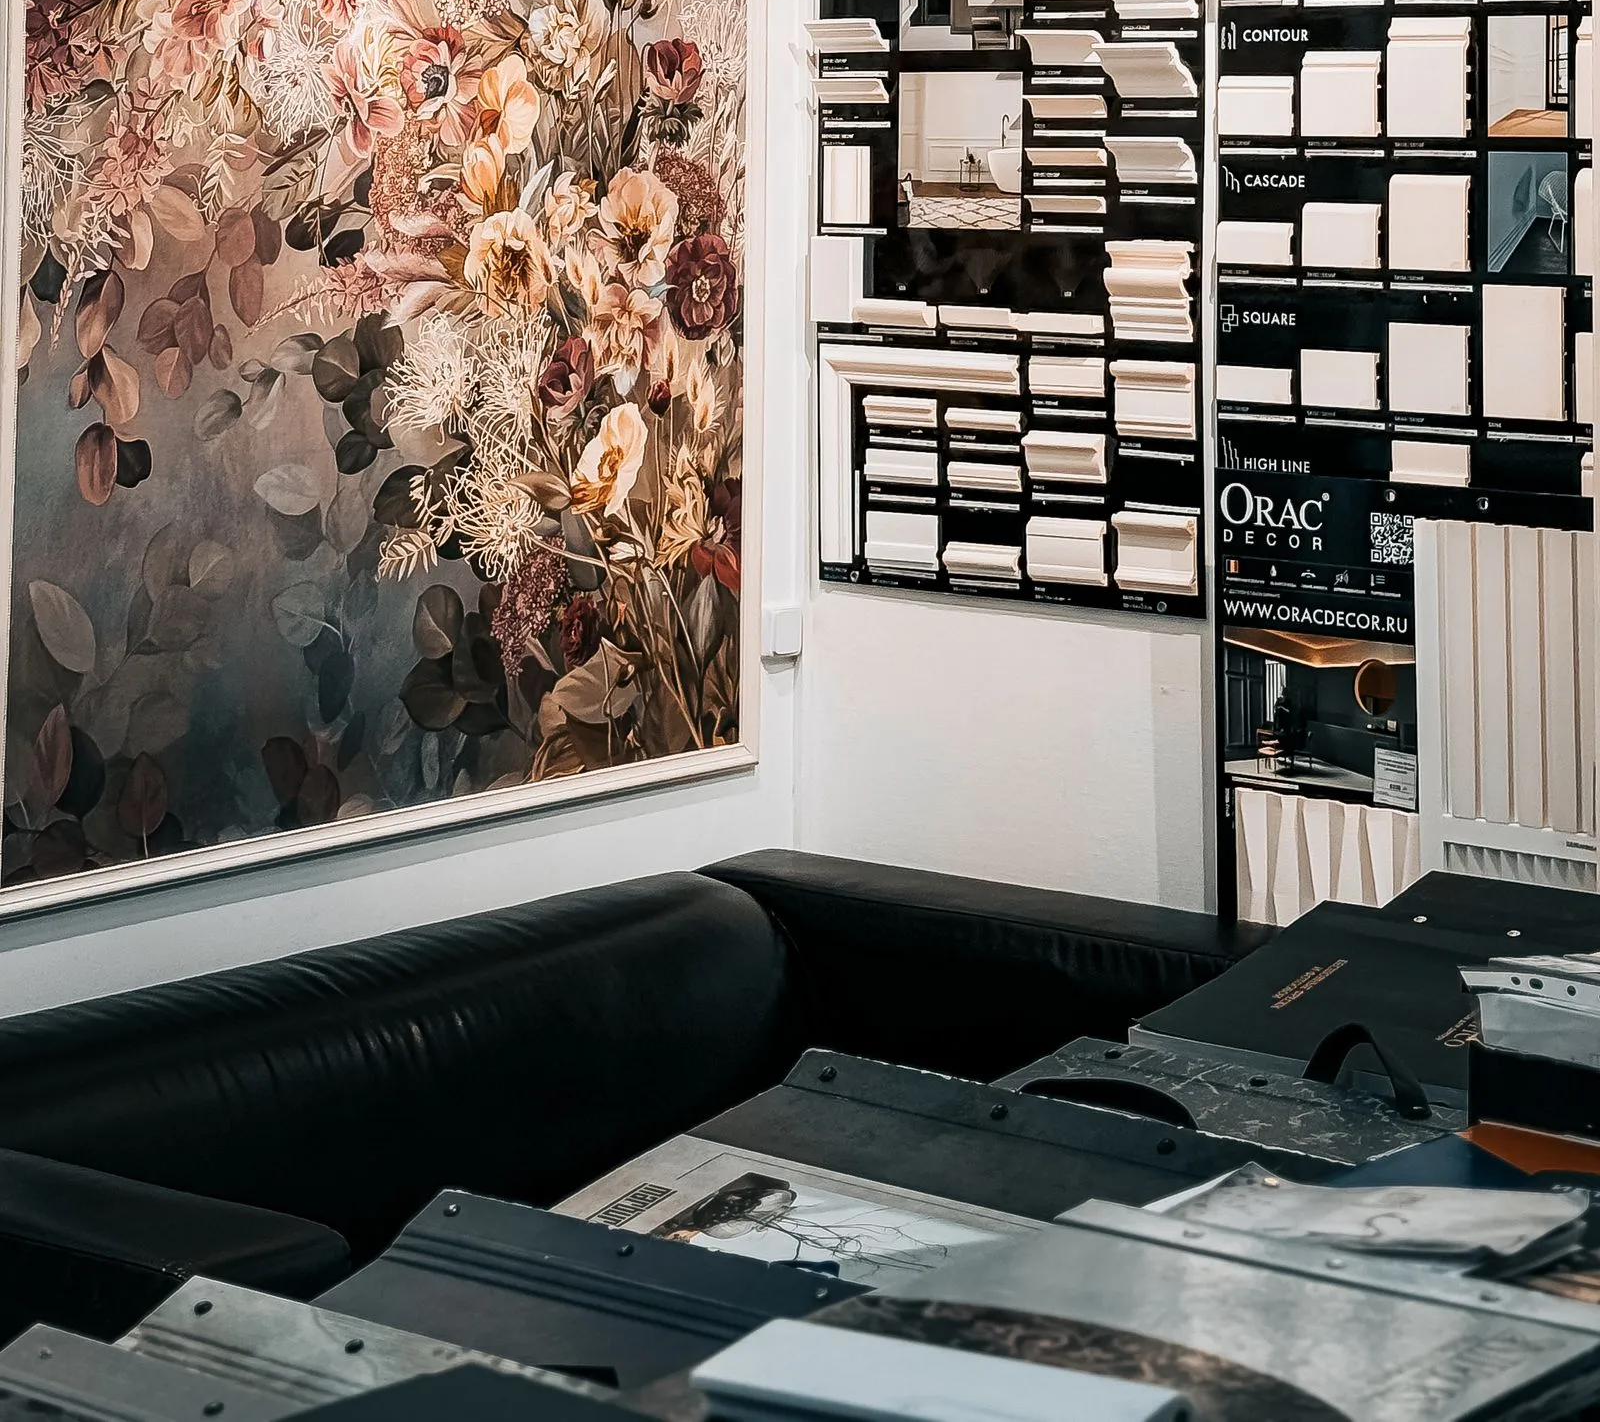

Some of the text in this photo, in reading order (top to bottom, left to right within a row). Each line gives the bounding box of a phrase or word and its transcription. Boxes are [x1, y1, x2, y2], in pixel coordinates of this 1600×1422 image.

[1242, 28, 1309, 43] CONTOUR
[1244, 174, 1306, 188] CASCADE
[1242, 311, 1296, 326] SQUARE
[1243, 457, 1311, 474] HIGH LINE
[1223, 528, 1323, 551] DECOR
[1223, 599, 1408, 634] WWW.ORACDECOR.RU
[596, 1183, 673, 1227] marbur
